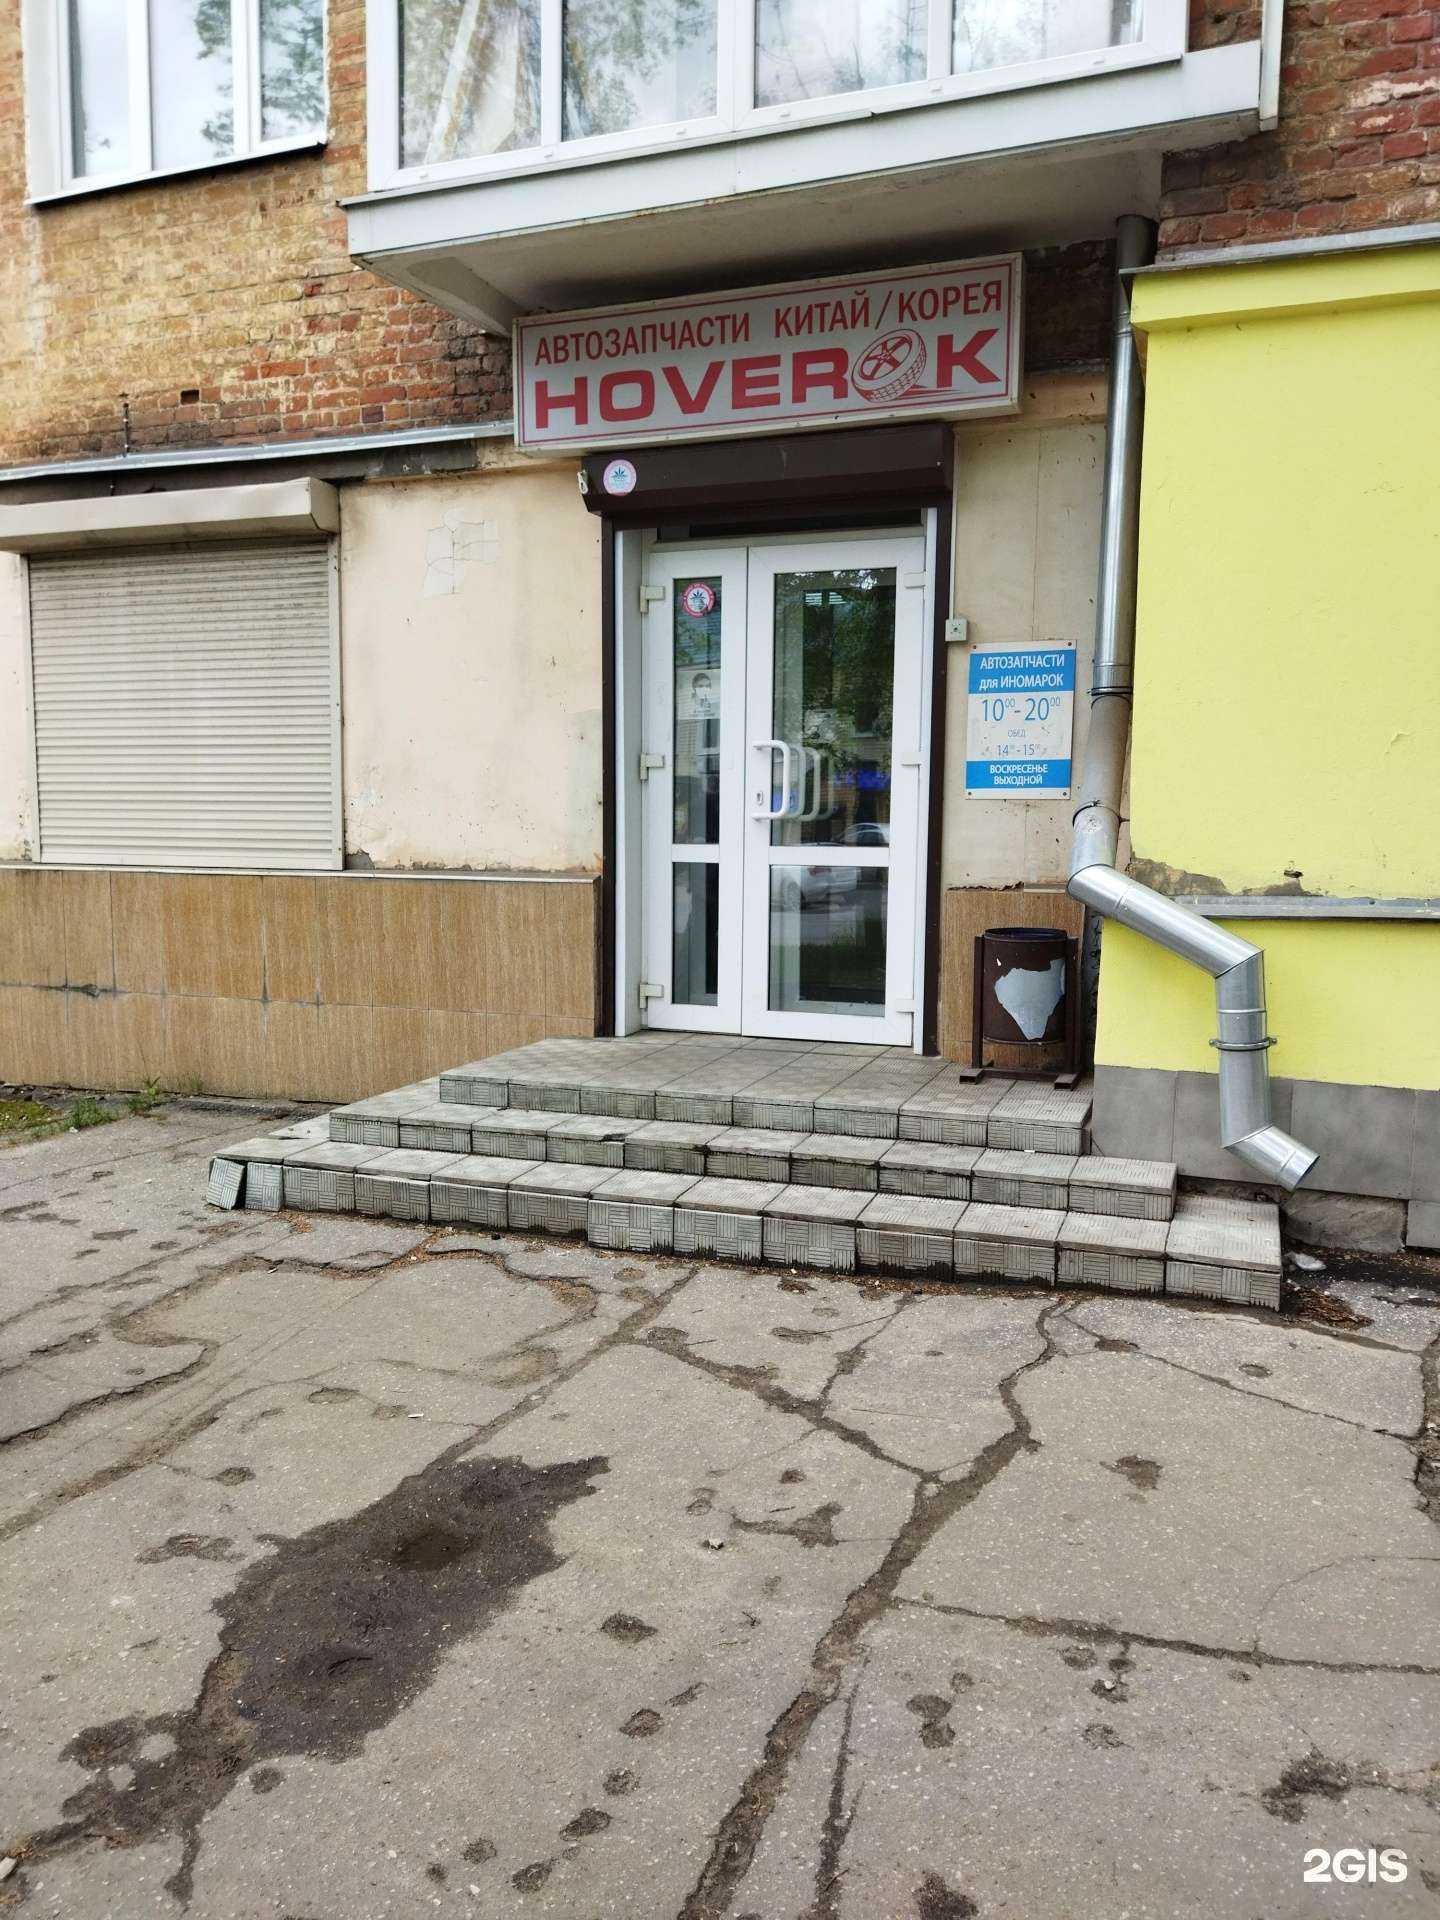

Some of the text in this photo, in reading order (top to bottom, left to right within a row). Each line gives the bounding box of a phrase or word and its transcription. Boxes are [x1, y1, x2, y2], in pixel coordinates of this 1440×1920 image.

[535, 312, 750, 366] АВТОЗАПЧАСТИ
[980, 654, 1065, 670] АВТОЗАПЧАСТИ
[979, 673, 1064, 692] для ИНОМАРОК
[990, 764, 1048, 774] ВОСКРЕСЕНЬЕ
[994, 775, 1043, 786] ВЫХОДНОЙ
